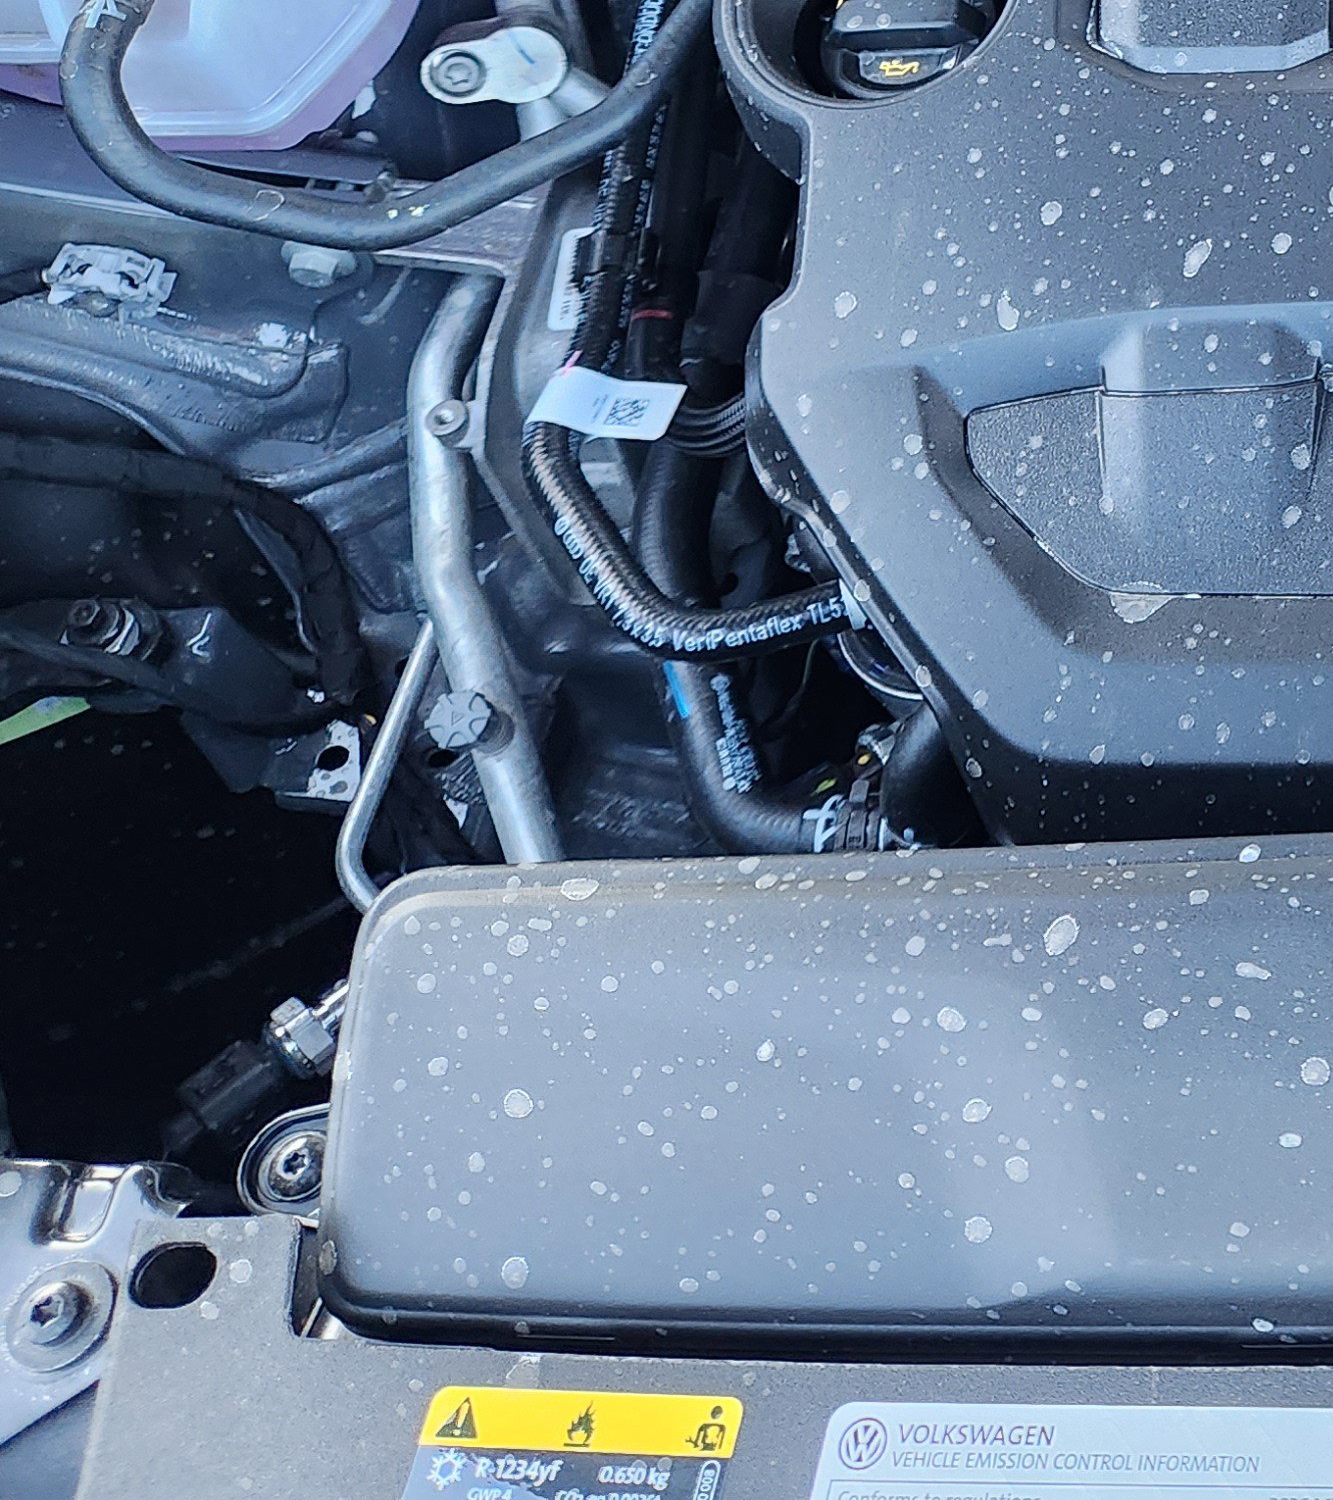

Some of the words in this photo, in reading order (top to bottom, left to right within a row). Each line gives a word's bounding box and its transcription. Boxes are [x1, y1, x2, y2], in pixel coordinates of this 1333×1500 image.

[672, 614, 803, 651] VeriPentaflex
[899, 1423, 1055, 1446] VOLKSWAGEN
[893, 1451, 961, 1468] VEHICLE
[965, 1452, 1049, 1469] EMISSION
[1053, 1453, 1133, 1471] CONTROL
[1137, 1454, 1260, 1473] INFORMATION
[598, 1465, 645, 1485] 0.650
[648, 1467, 672, 1491] kg
